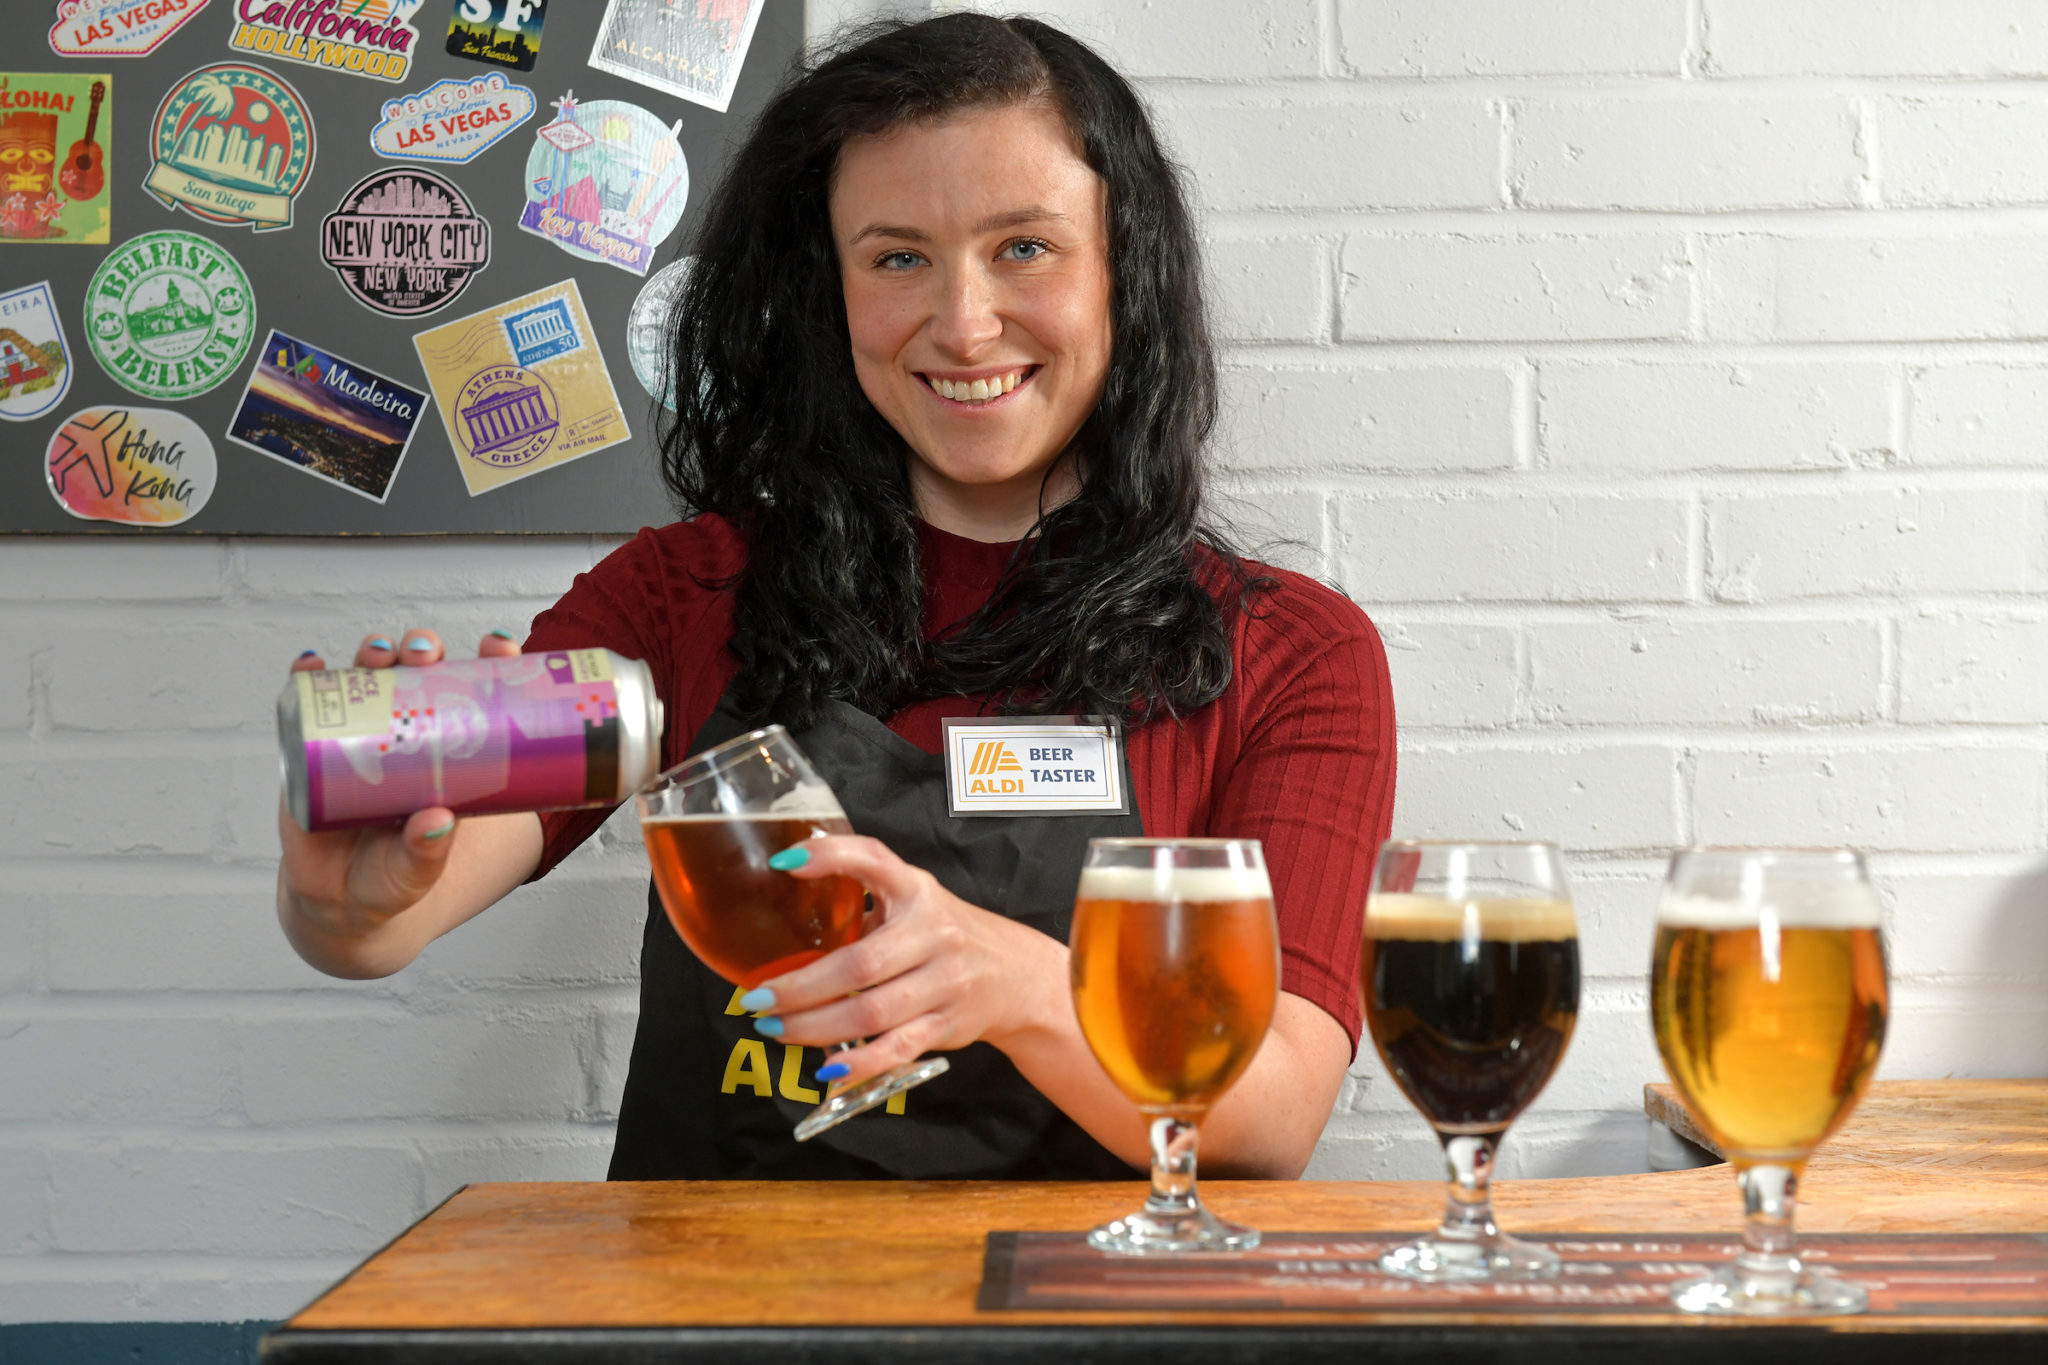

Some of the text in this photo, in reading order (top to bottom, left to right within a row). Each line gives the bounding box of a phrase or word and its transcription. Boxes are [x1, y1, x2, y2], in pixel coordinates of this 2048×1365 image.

[74, 18, 114, 47] LAS
[117, 0, 188, 29] VEGAS
[115, 23, 159, 43] NEVADA
[239, 0, 413, 53] California
[234, 23, 408, 80] HOLLYWOOD
[461, 41, 519, 63] San Francisco
[615, 37, 717, 83] ALCATRAZ
[0, 89, 75, 112] LOHA!
[388, 79, 500, 118] WELCOME
[421, 98, 491, 125] Fabulous
[396, 102, 512, 149] LAS VEGAS
[436, 132, 481, 149] NEVADA
[183, 181, 256, 213] San Diego
[329, 219, 482, 261] NEW YORK CITY
[540, 207, 642, 264] Las Vegas
[99, 242, 225, 301] BELFAST
[364, 267, 447, 293] NEW YORK
[2, 296, 43, 316] EIRA
[112, 327, 239, 387] BELFAST
[522, 334, 577, 364] ATHENS 50
[323, 363, 412, 420] Madeira
[467, 369, 525, 399] ATHENS
[491, 435, 547, 464] GREECE
[558, 434, 607, 451] VIA AIR MAIL
[1030, 748, 1074, 761] BEER
[970, 779, 1024, 793] ALDI
[1030, 769, 1096, 783] TASTER
[721, 1037, 908, 1116] AL
